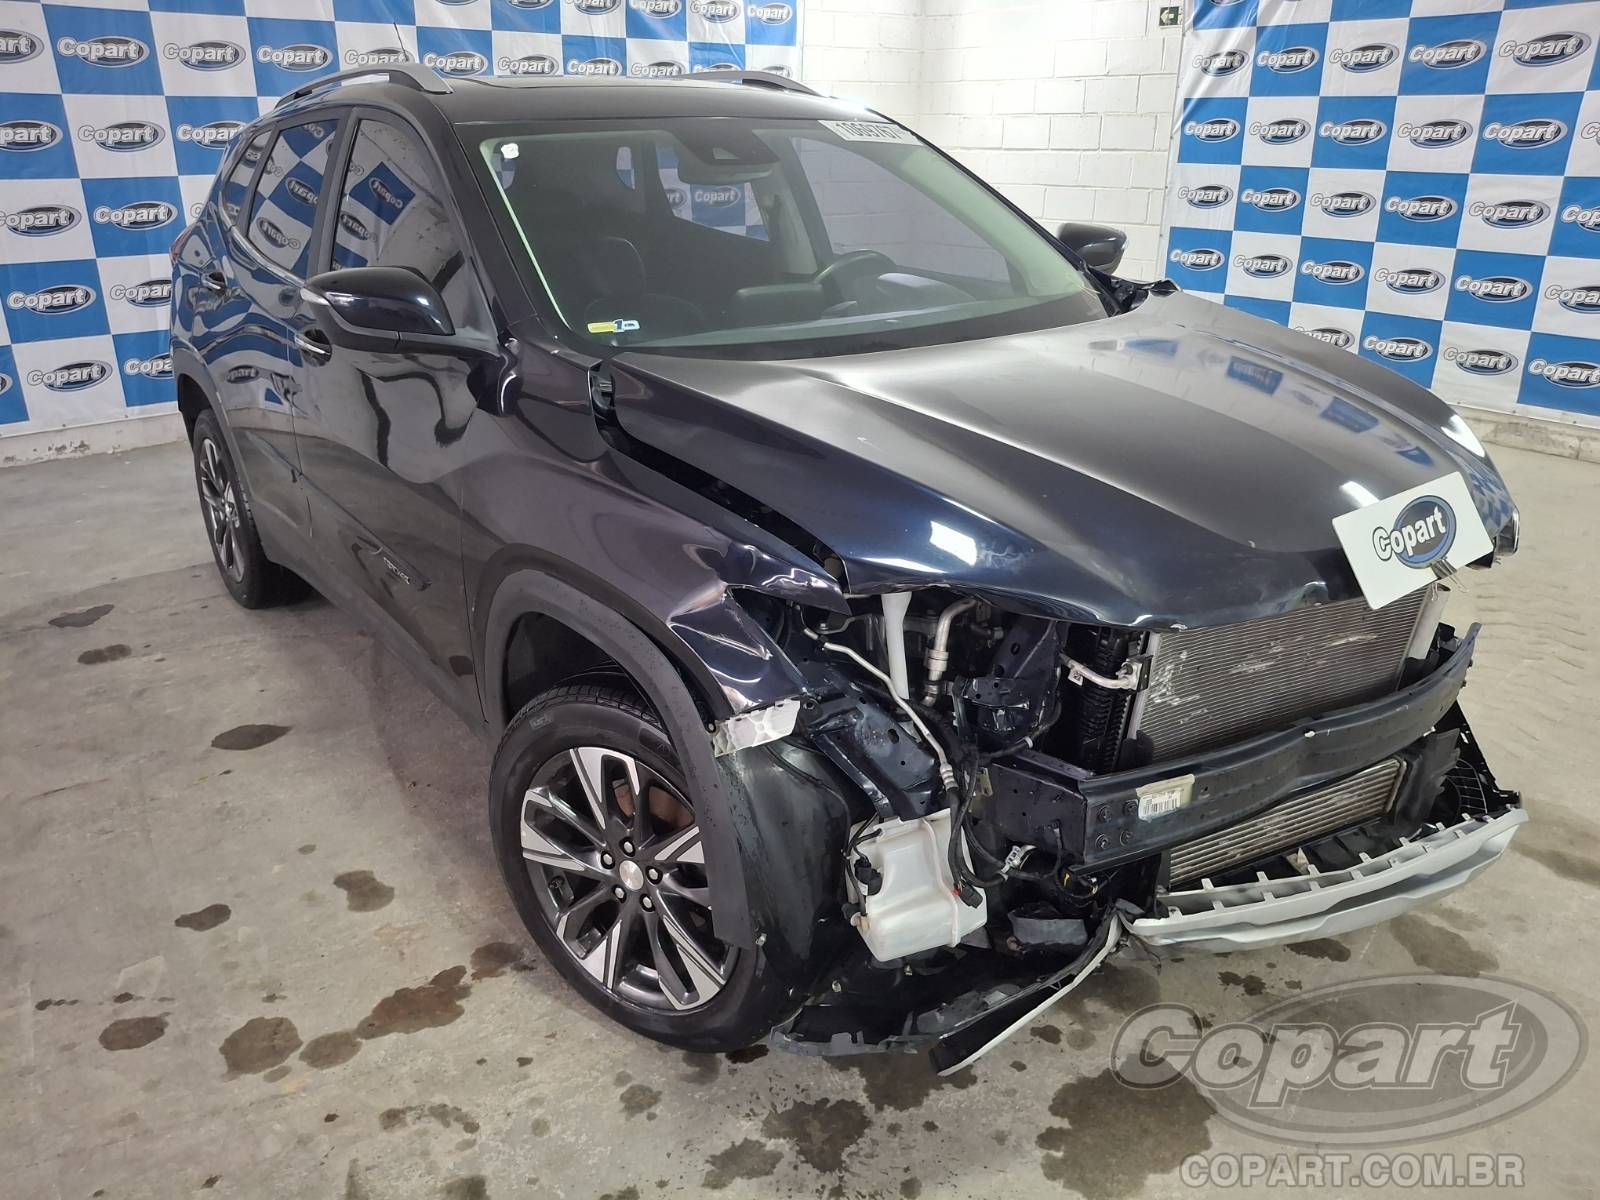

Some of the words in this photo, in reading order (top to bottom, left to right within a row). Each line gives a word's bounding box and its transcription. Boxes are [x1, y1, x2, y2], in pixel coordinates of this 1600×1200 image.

[691, 1, 734, 16] Copart
[748, 5, 788, 19] Copart
[58, 37, 140, 61] Copart
[163, 43, 234, 62] Copart
[257, 45, 325, 67] Copart
[1330, 47, 1392, 64] Copart
[1408, 43, 1478, 64] Copart
[1499, 36, 1579, 61] Copart
[423, 53, 482, 70] Copart
[498, 57, 550, 74] Copart
[567, 60, 617, 76] Copart
[1193, 55, 1241, 71] Copart
[1257, 51, 1311, 69] Copart
[631, 63, 679, 77] Copart
[0, 128, 51, 145] part
[78, 126, 154, 145] Copart
[1184, 121, 1234, 138] Copart
[1250, 122, 1301, 139] Copart
[1319, 122, 1378, 140] Copart
[1398, 123, 1464, 140] Copart
[1483, 122, 1558, 143] Copart
[694, 190, 735, 204] Copart
[1178, 186, 1227, 203] Copart
[1242, 189, 1294, 206] Copart
[1310, 193, 1367, 211] Copart
[94, 205, 167, 223] Copart
[1385, 197, 1450, 217] Copart
[1469, 201, 1542, 221] Copart
[1562, 206, 1600, 226] Cop
[1170, 249, 1219, 266] Copart
[1233, 255, 1284, 272] Copart
[1301, 261, 1357, 279] Copart
[1374, 268, 1439, 287] Copart
[111, 284, 171, 302] Copar
[1455, 275, 1524, 297] Copart
[8, 289, 86, 311] Copart
[1545, 285, 1600, 306] Copa
[1363, 335, 1426, 357] Copart
[124, 358, 172, 375] Copa
[1444, 347, 1511, 369] Copart
[27, 366, 101, 387] Copart
[1372, 506, 1446, 561] Copart
